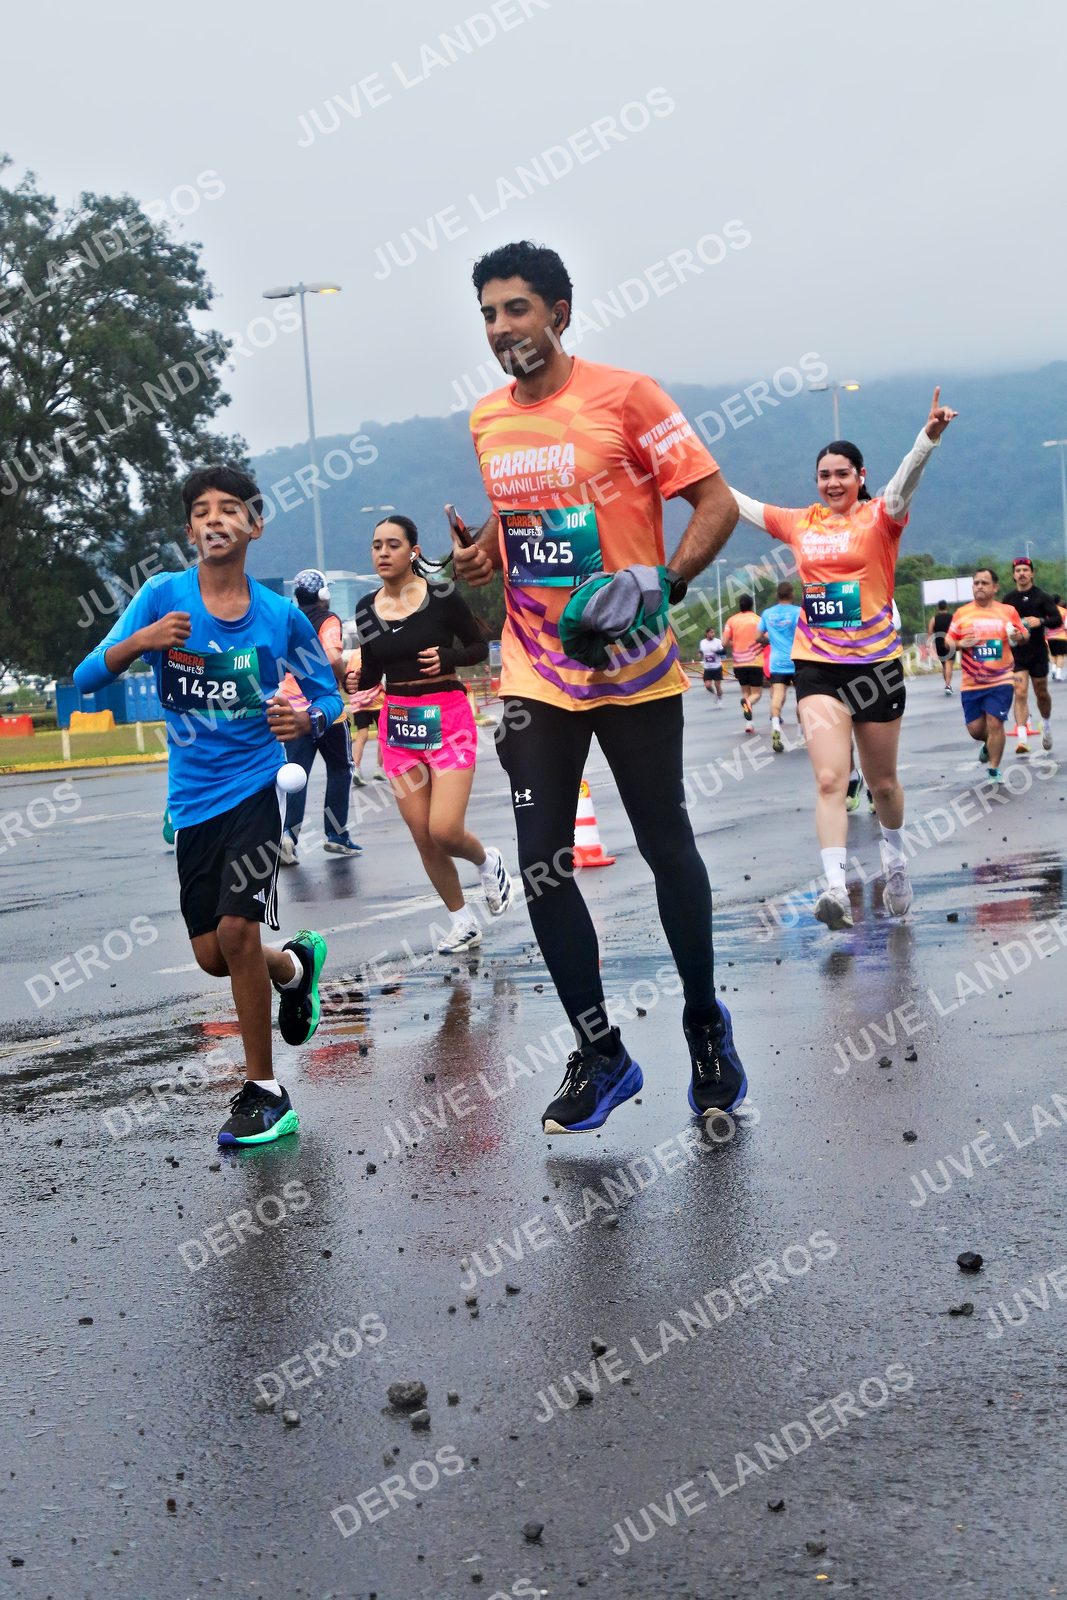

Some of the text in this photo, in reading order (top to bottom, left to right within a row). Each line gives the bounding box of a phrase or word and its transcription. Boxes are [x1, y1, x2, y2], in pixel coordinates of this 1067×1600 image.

[489, 443, 575, 480] CARRERA
[506, 515, 543, 527] CARRERA
[566, 511, 587, 529] 10K
[520, 541, 573, 564] 1425
[812, 601, 844, 615] 1361
[168, 648, 206, 666] CARRERA
[233, 653, 251, 670] 10K
[178, 676, 237, 700] 1428
[395, 723, 428, 738] 1628
